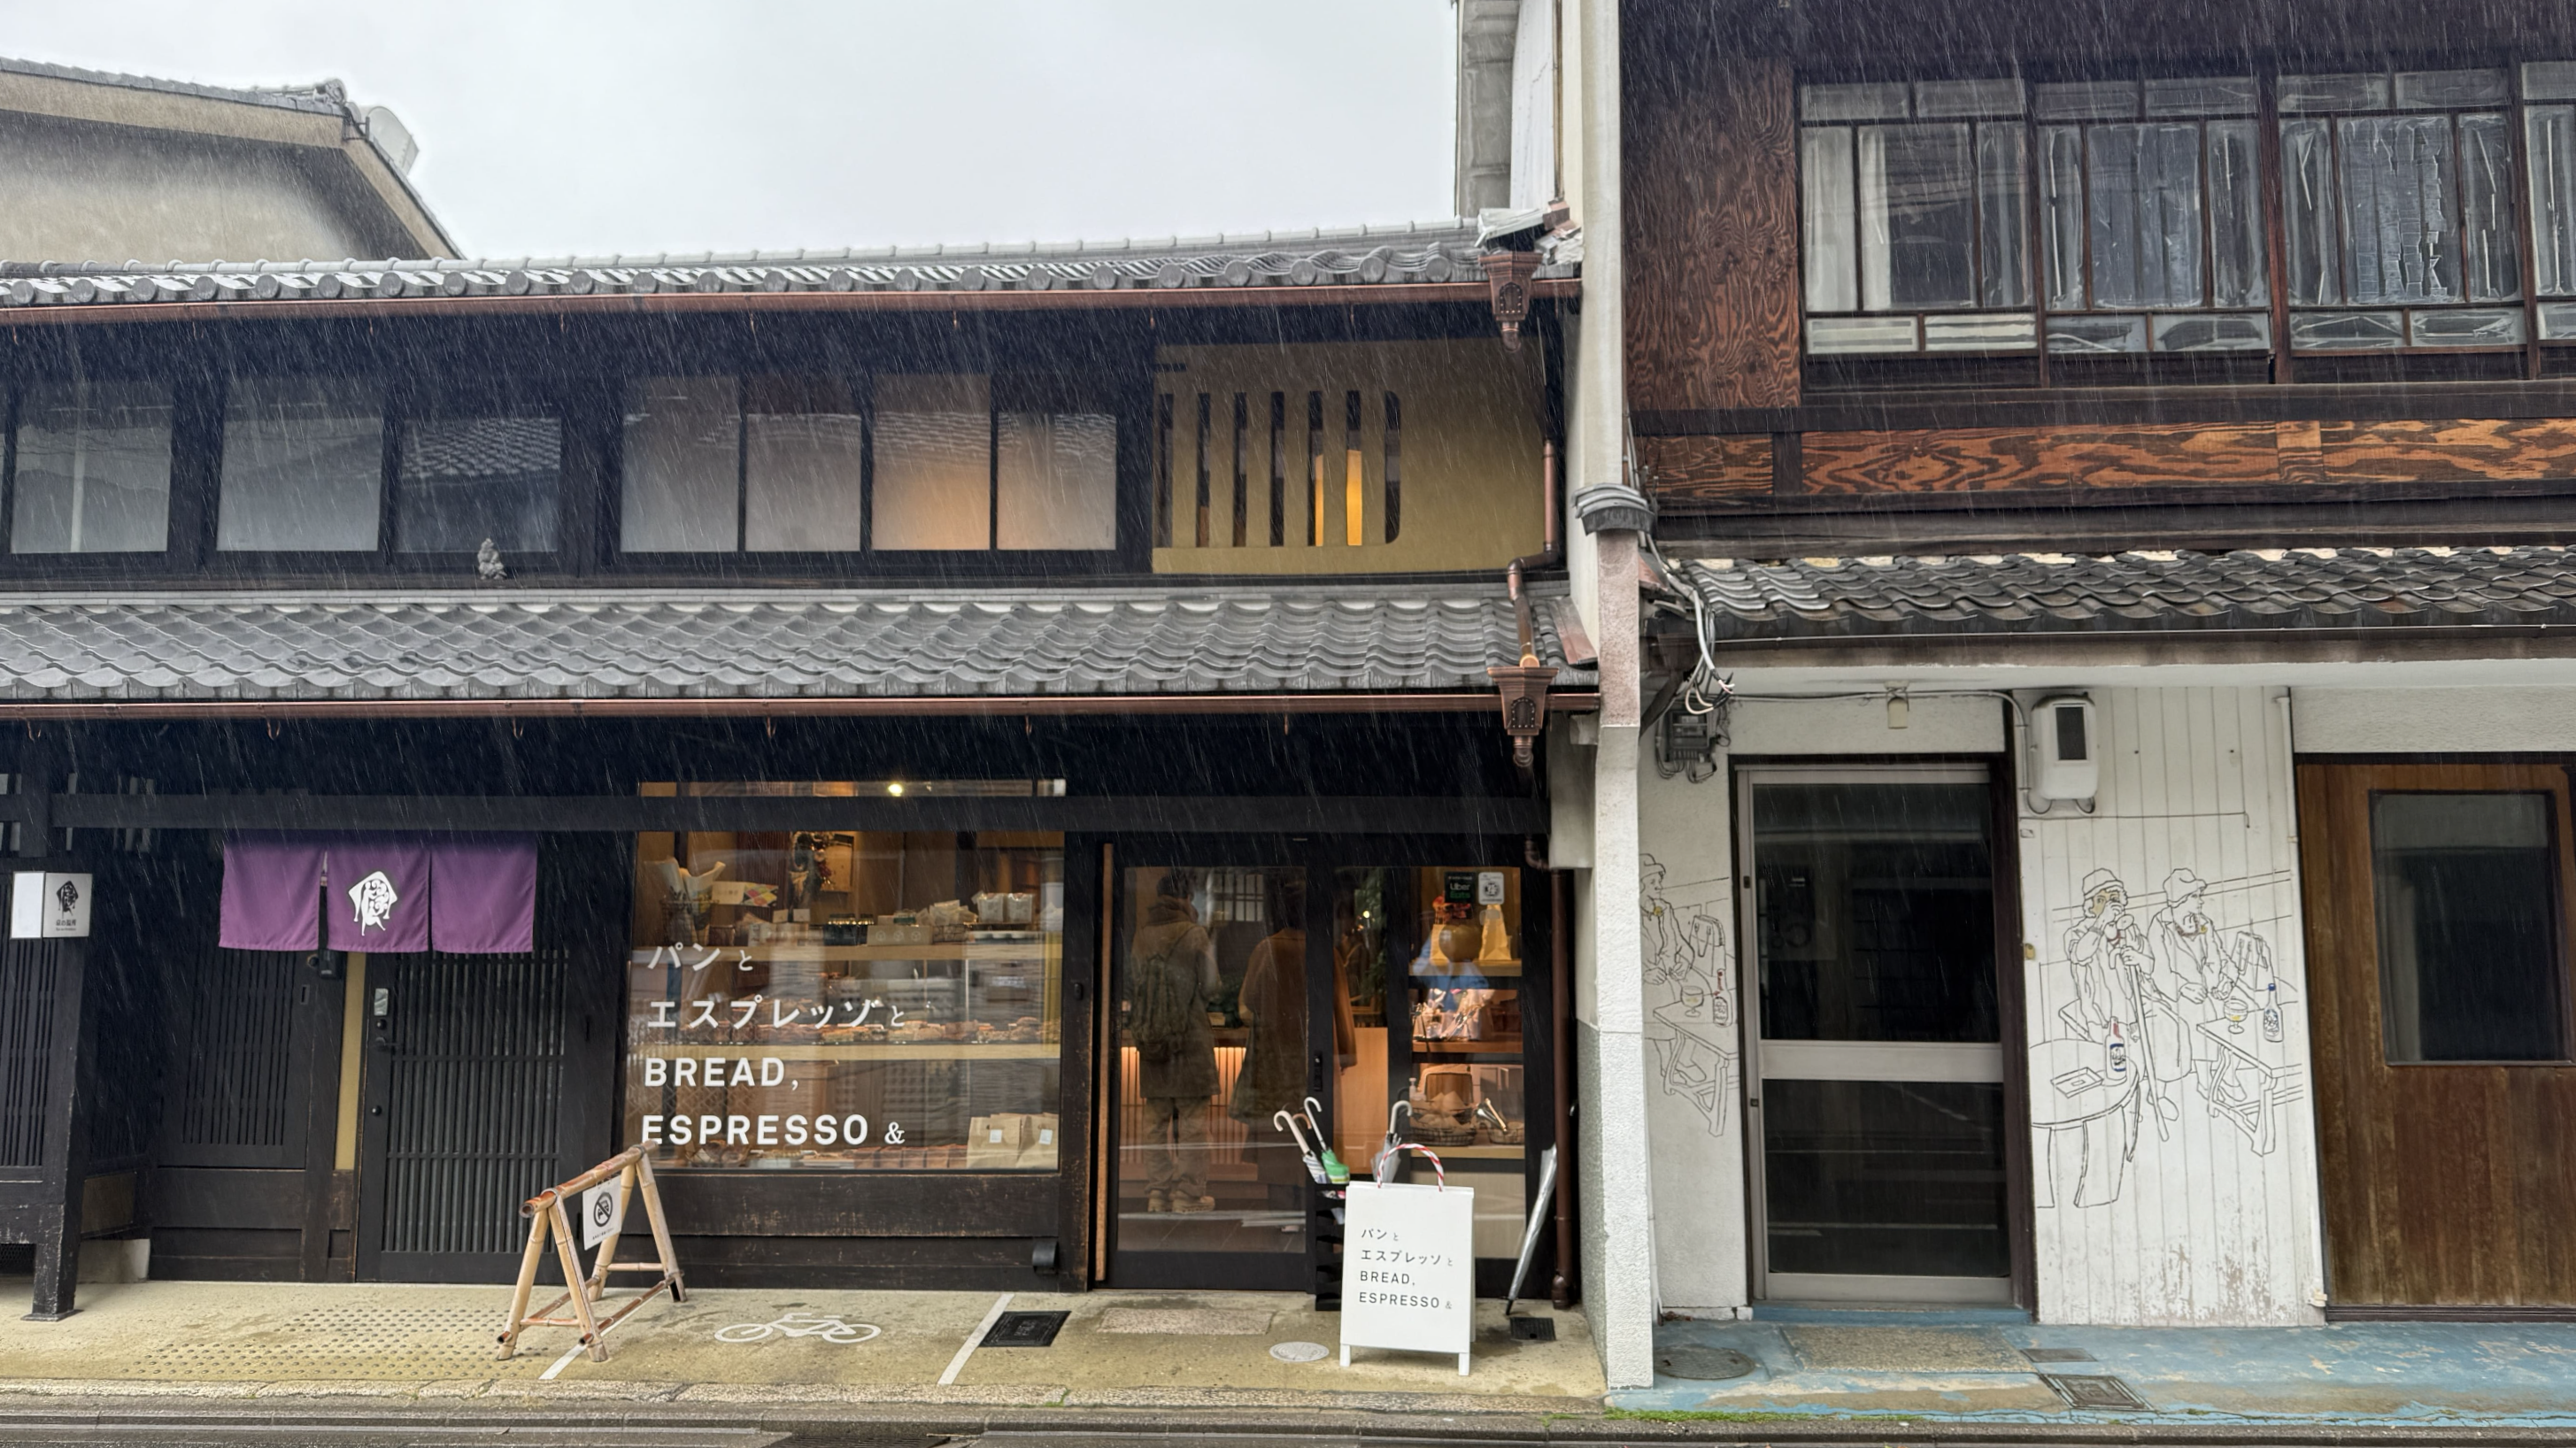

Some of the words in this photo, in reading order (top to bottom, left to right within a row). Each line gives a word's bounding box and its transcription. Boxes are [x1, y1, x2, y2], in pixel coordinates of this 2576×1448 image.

[644, 1057, 799, 1091] BREAD,
[642, 1114, 868, 1146] ESPRESSO
[883, 1121, 906, 1145] &
[1360, 1270, 1415, 1286] BREAD,
[1359, 1291, 1440, 1308] ESPRESSO
[1445, 1301, 1453, 1310] &
